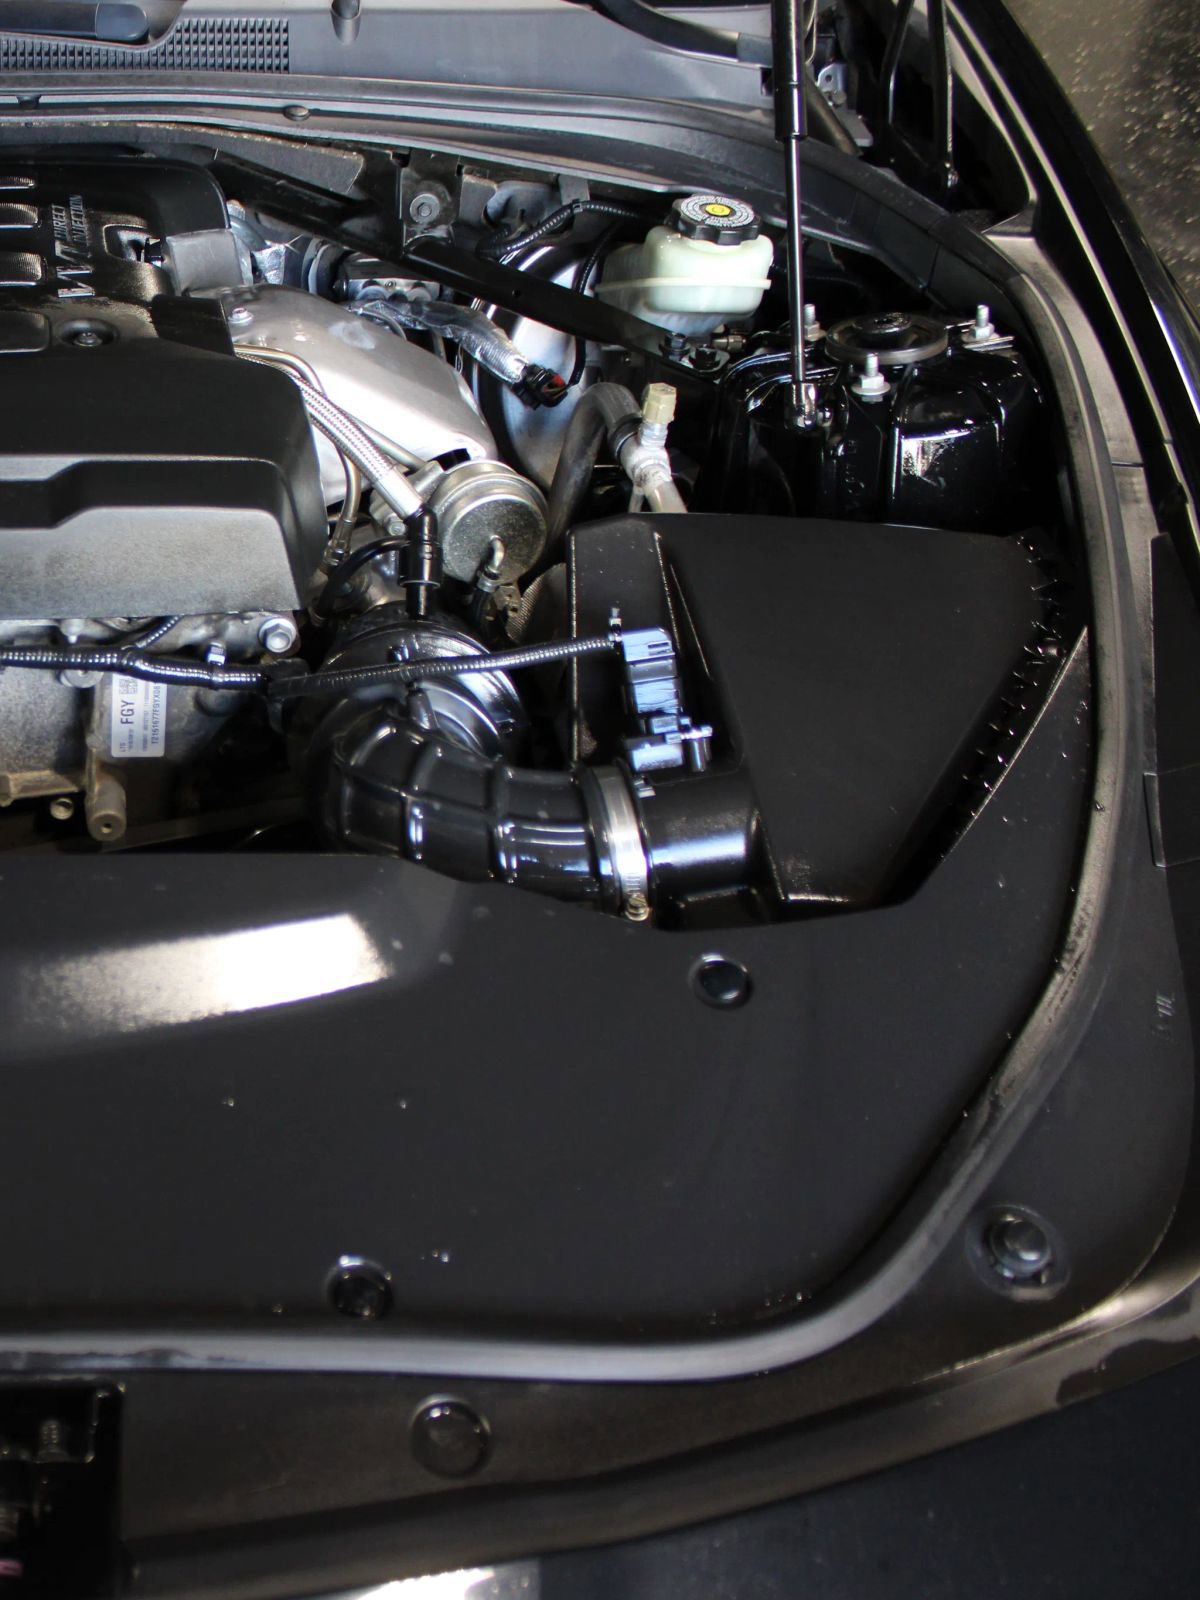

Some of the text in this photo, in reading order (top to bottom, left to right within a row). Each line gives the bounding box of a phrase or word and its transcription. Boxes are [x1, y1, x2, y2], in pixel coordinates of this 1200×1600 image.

[51, 203, 66, 239] DIRECT
[69, 194, 84, 243] INJECTION
[120, 700, 135, 725] FGY
